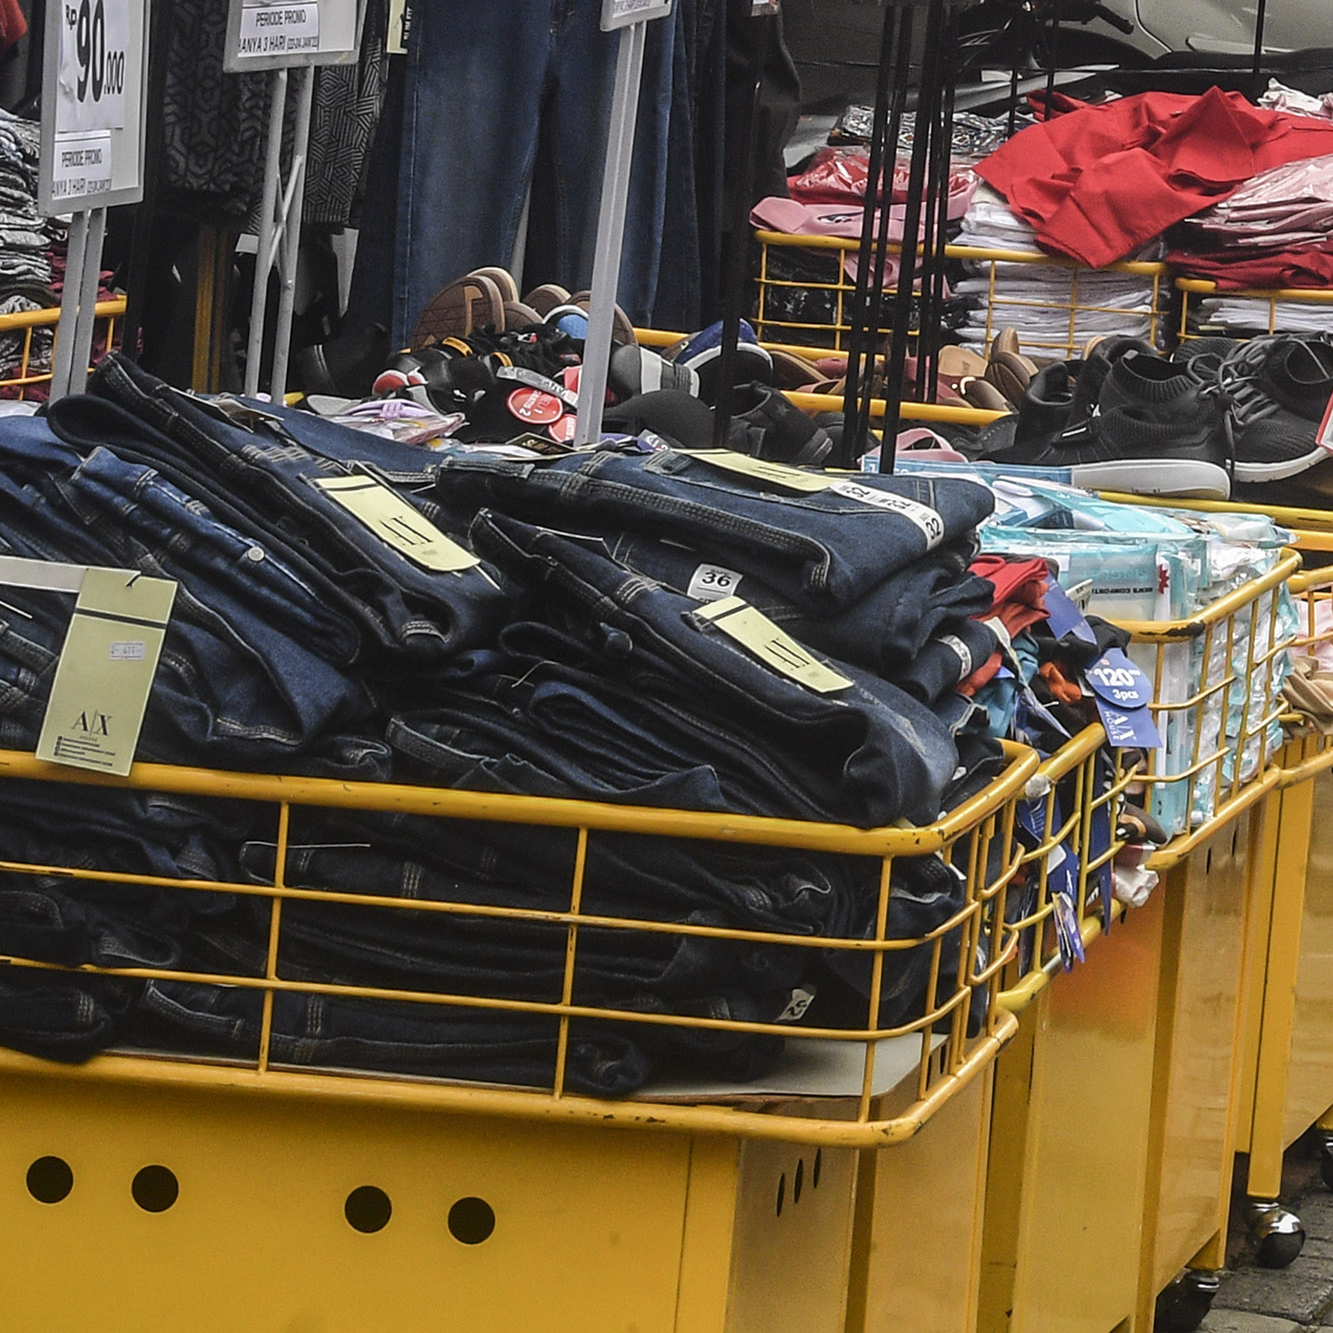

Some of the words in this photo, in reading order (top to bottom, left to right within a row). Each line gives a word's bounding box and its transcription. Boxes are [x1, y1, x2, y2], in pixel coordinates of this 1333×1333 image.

[925, 517, 942, 540] 32
[702, 571, 732, 587] 36
[1112, 688, 1139, 702] 3pcs
